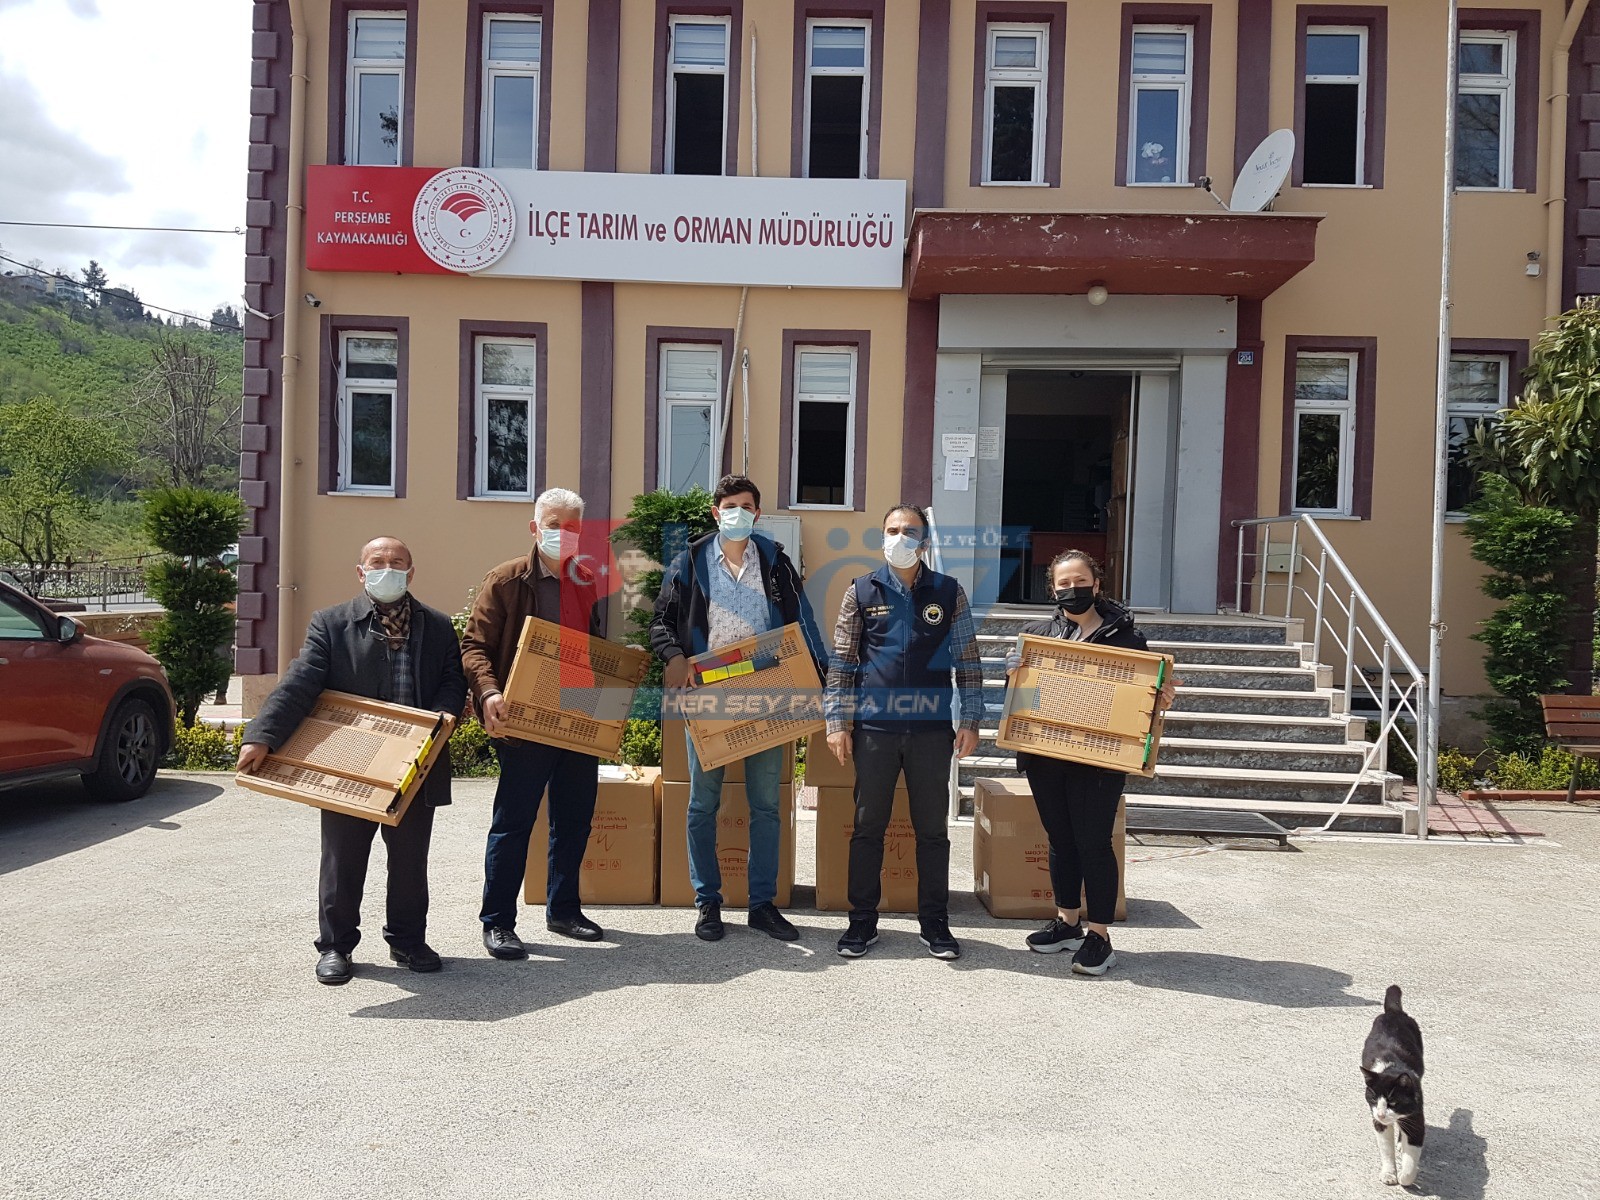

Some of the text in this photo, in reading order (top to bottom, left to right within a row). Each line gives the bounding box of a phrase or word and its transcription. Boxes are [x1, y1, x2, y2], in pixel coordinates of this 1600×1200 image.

[352, 192, 374, 203] T.C.
[334, 212, 391, 226] PERŞEMBE
[528, 203, 894, 249] İLÇE TARIM ve ORMAN MÜDÜRLÜĞÜ
[317, 231, 408, 246] KAYMAKAMLIĞI
